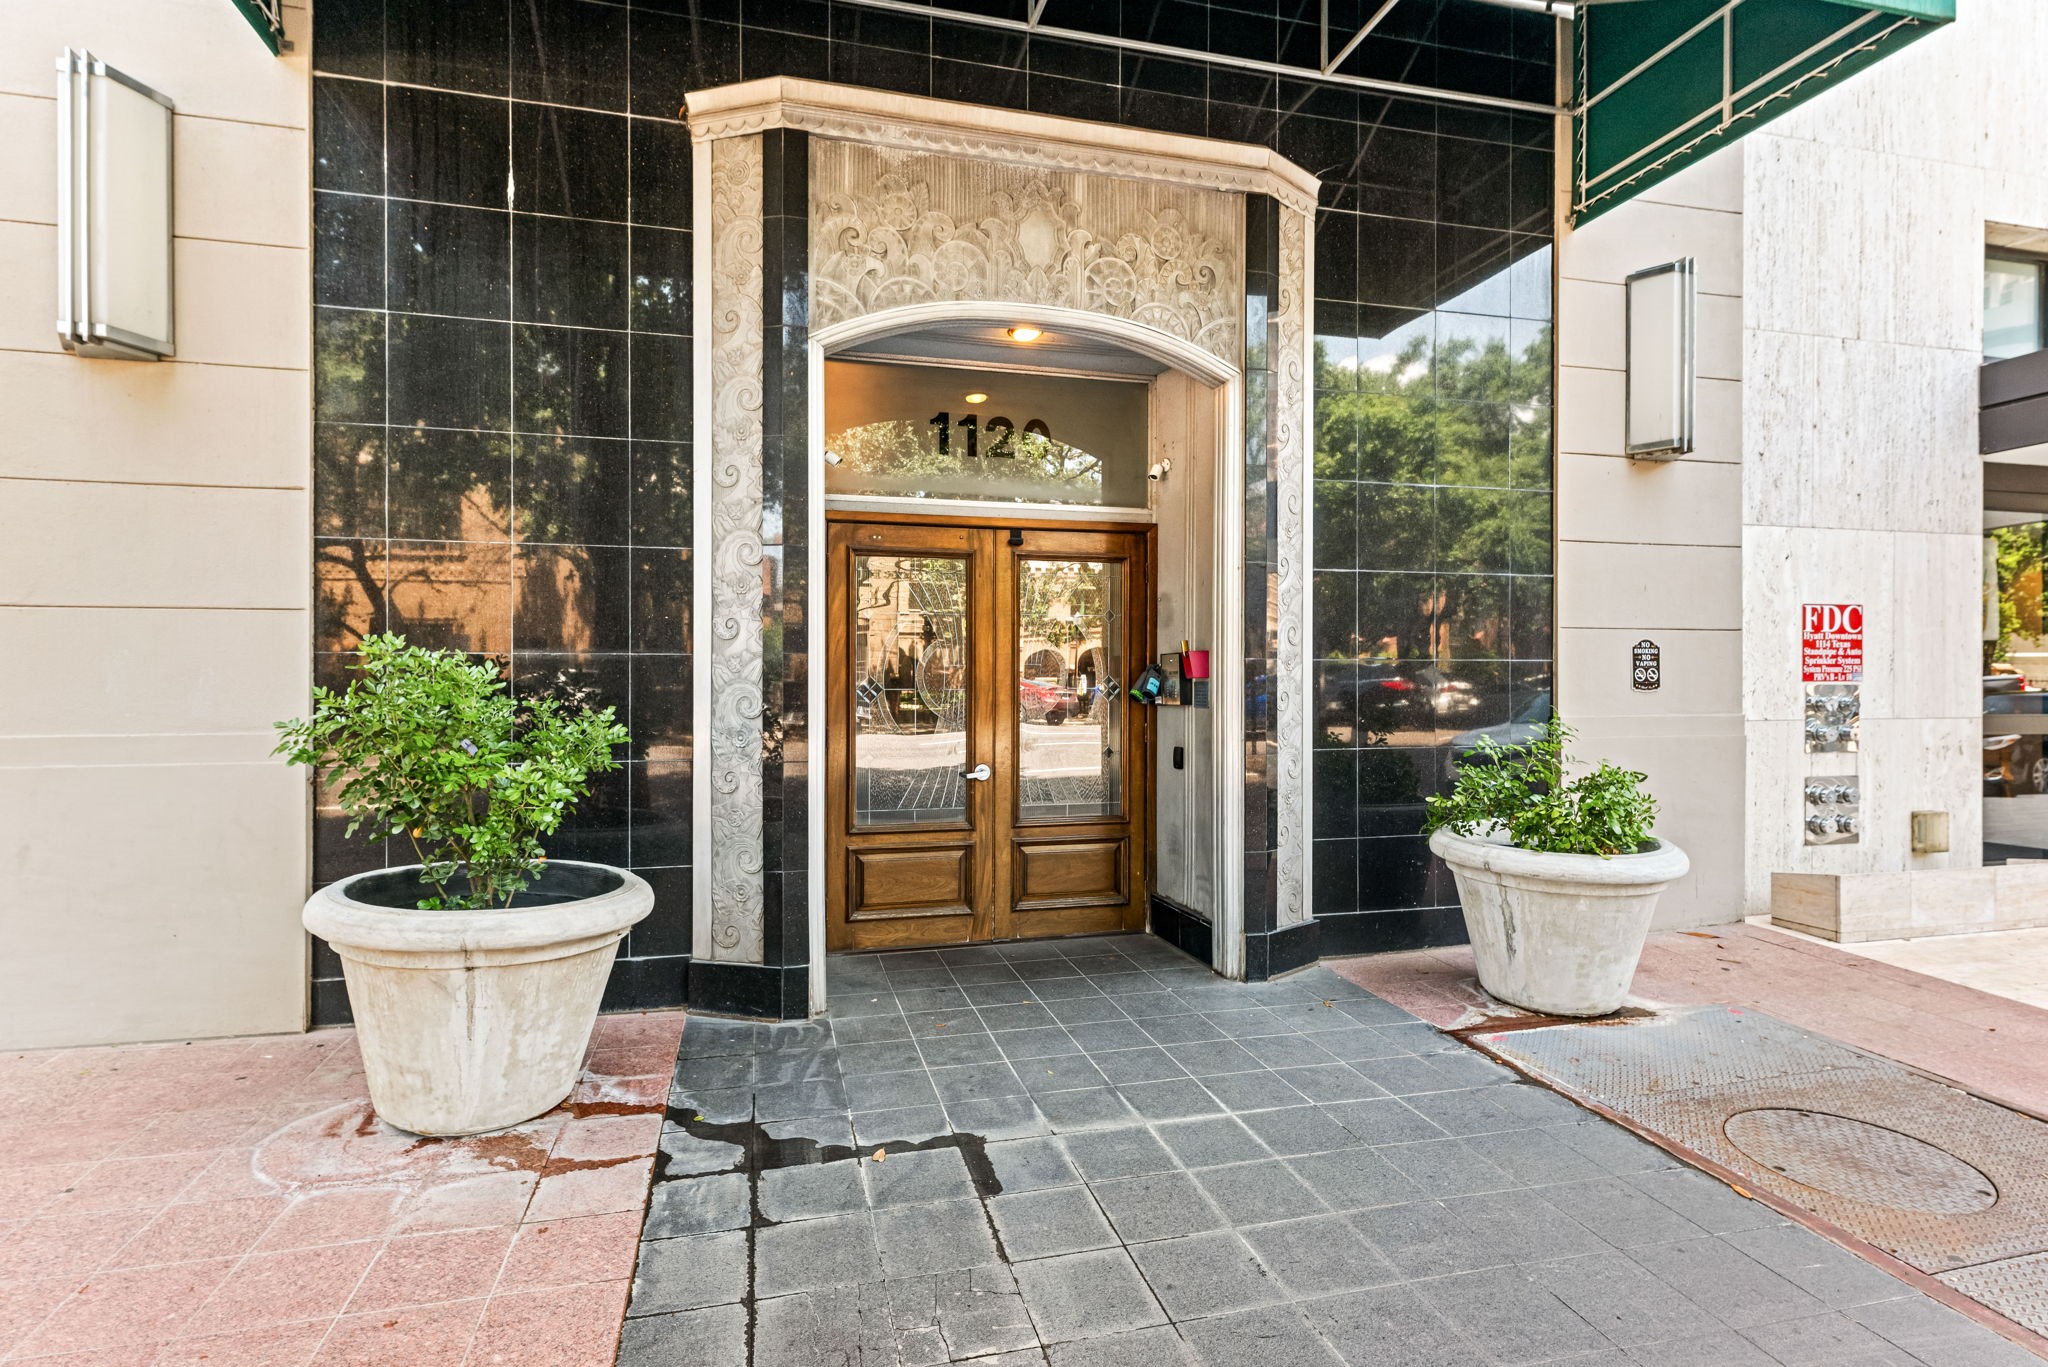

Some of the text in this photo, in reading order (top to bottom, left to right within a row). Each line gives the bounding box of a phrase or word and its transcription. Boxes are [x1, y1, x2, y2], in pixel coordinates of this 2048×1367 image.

[1803, 605, 1862, 633] FDC
[1804, 632, 1862, 641] Hyatt Downtown
[1815, 640, 1851, 648] 1114 Texas
[1804, 647, 1837, 657] Standpipe
[1845, 648, 1862, 656] Auto
[1805, 656, 1861, 666] Sprinkler System
